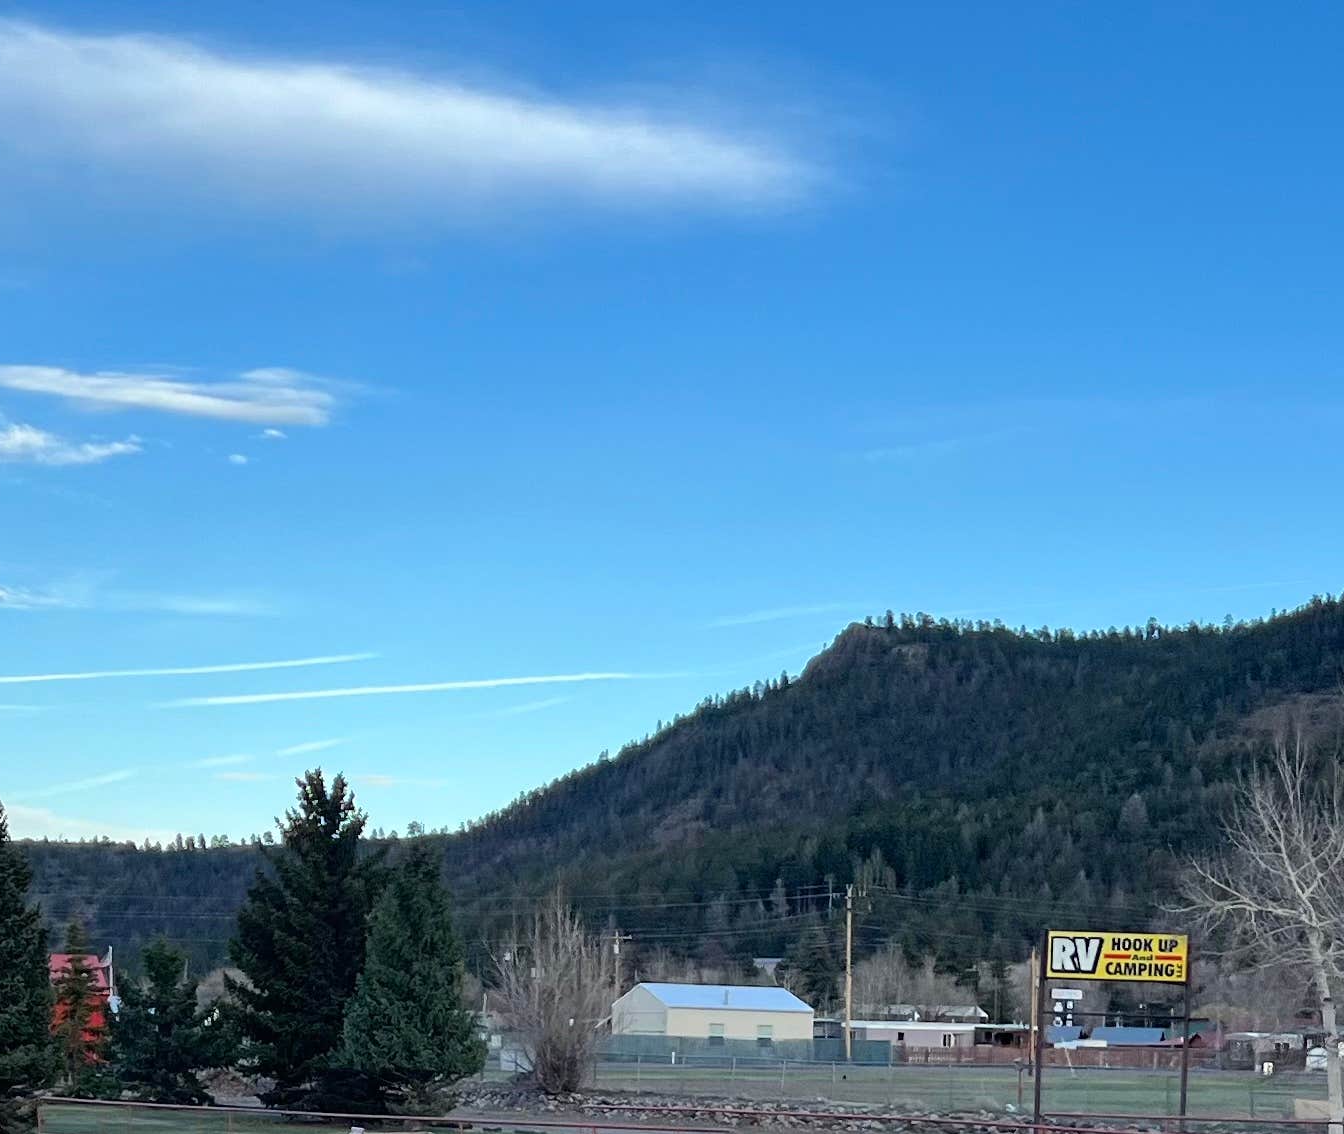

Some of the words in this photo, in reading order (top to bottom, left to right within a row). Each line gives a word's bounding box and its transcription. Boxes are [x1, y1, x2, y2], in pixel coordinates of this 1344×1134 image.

[1111, 938, 1153, 952] HOOK
[1158, 939, 1178, 953] UP
[1051, 937, 1104, 974] RV
[1105, 961, 1175, 977] CAMPING
